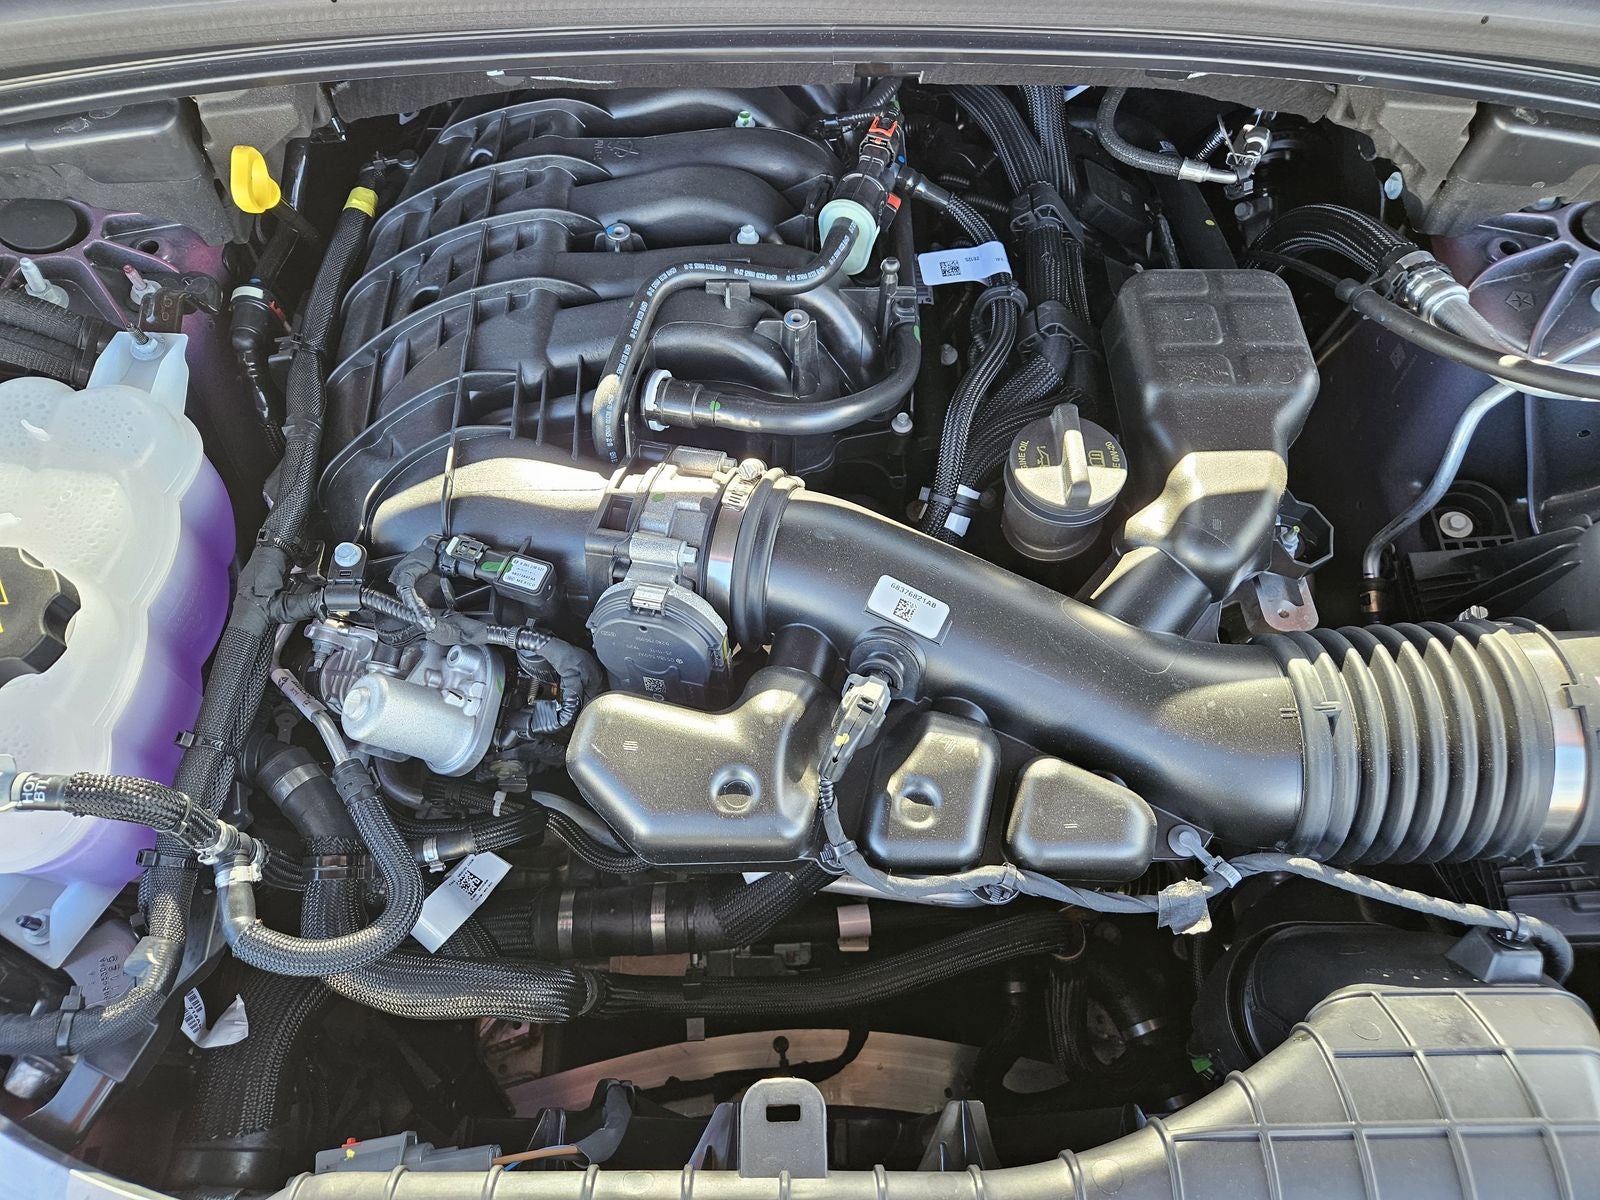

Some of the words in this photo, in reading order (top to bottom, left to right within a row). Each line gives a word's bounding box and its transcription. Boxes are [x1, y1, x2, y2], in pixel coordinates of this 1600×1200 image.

[1019, 440, 1029, 452] OIL
[890, 582, 937, 609] 68376821AB
[22, 775, 40, 804] HOT
